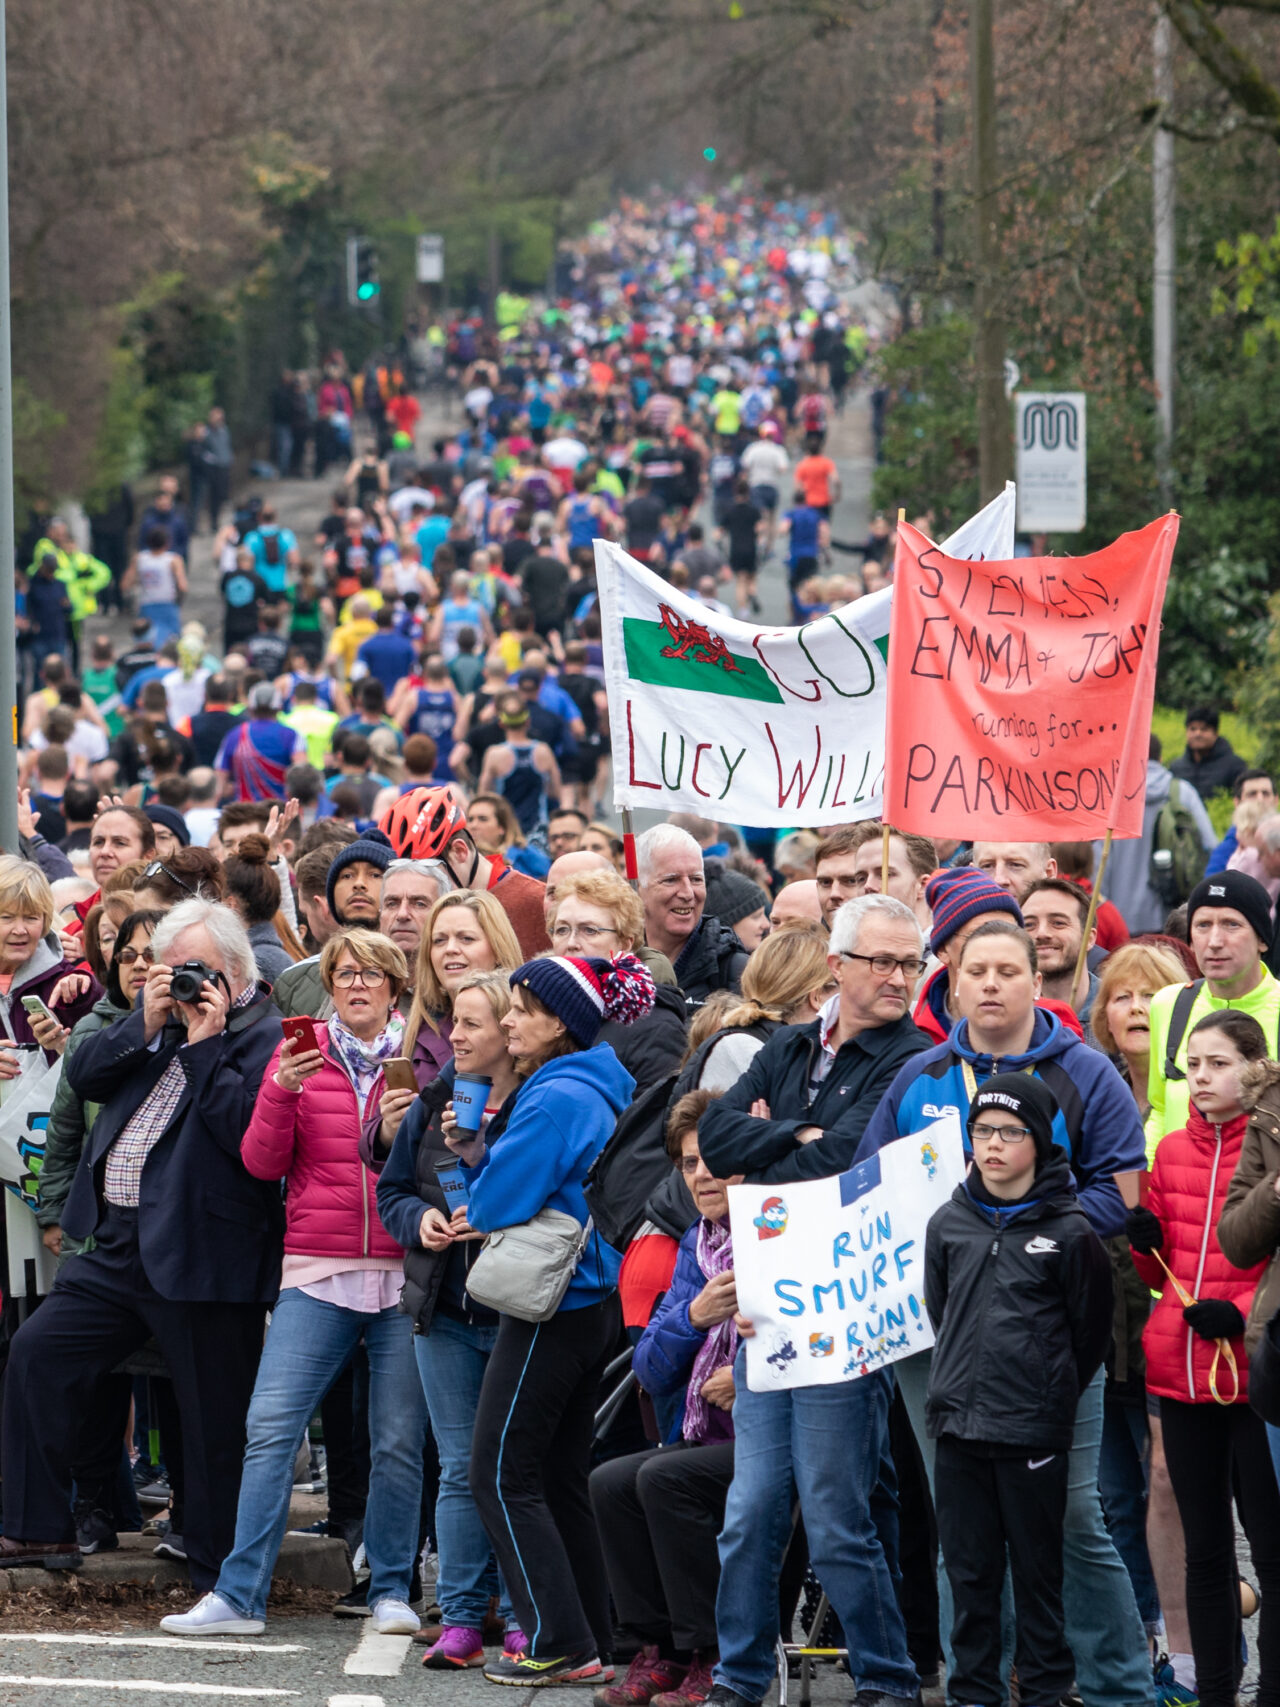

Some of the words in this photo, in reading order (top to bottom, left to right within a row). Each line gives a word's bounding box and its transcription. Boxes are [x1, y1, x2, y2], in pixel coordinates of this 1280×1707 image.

[752, 613, 875, 702] GO
[910, 615, 1033, 690] EMMA
[1068, 624, 1148, 684] JOH
[626, 700, 747, 800] LUCY
[971, 711, 1040, 758] running
[978, 1092, 1021, 1111] FORTNITE
[833, 1210, 892, 1269] RUN
[773, 1239, 916, 1317] SMURF
[846, 1293, 924, 1352] RUN!
